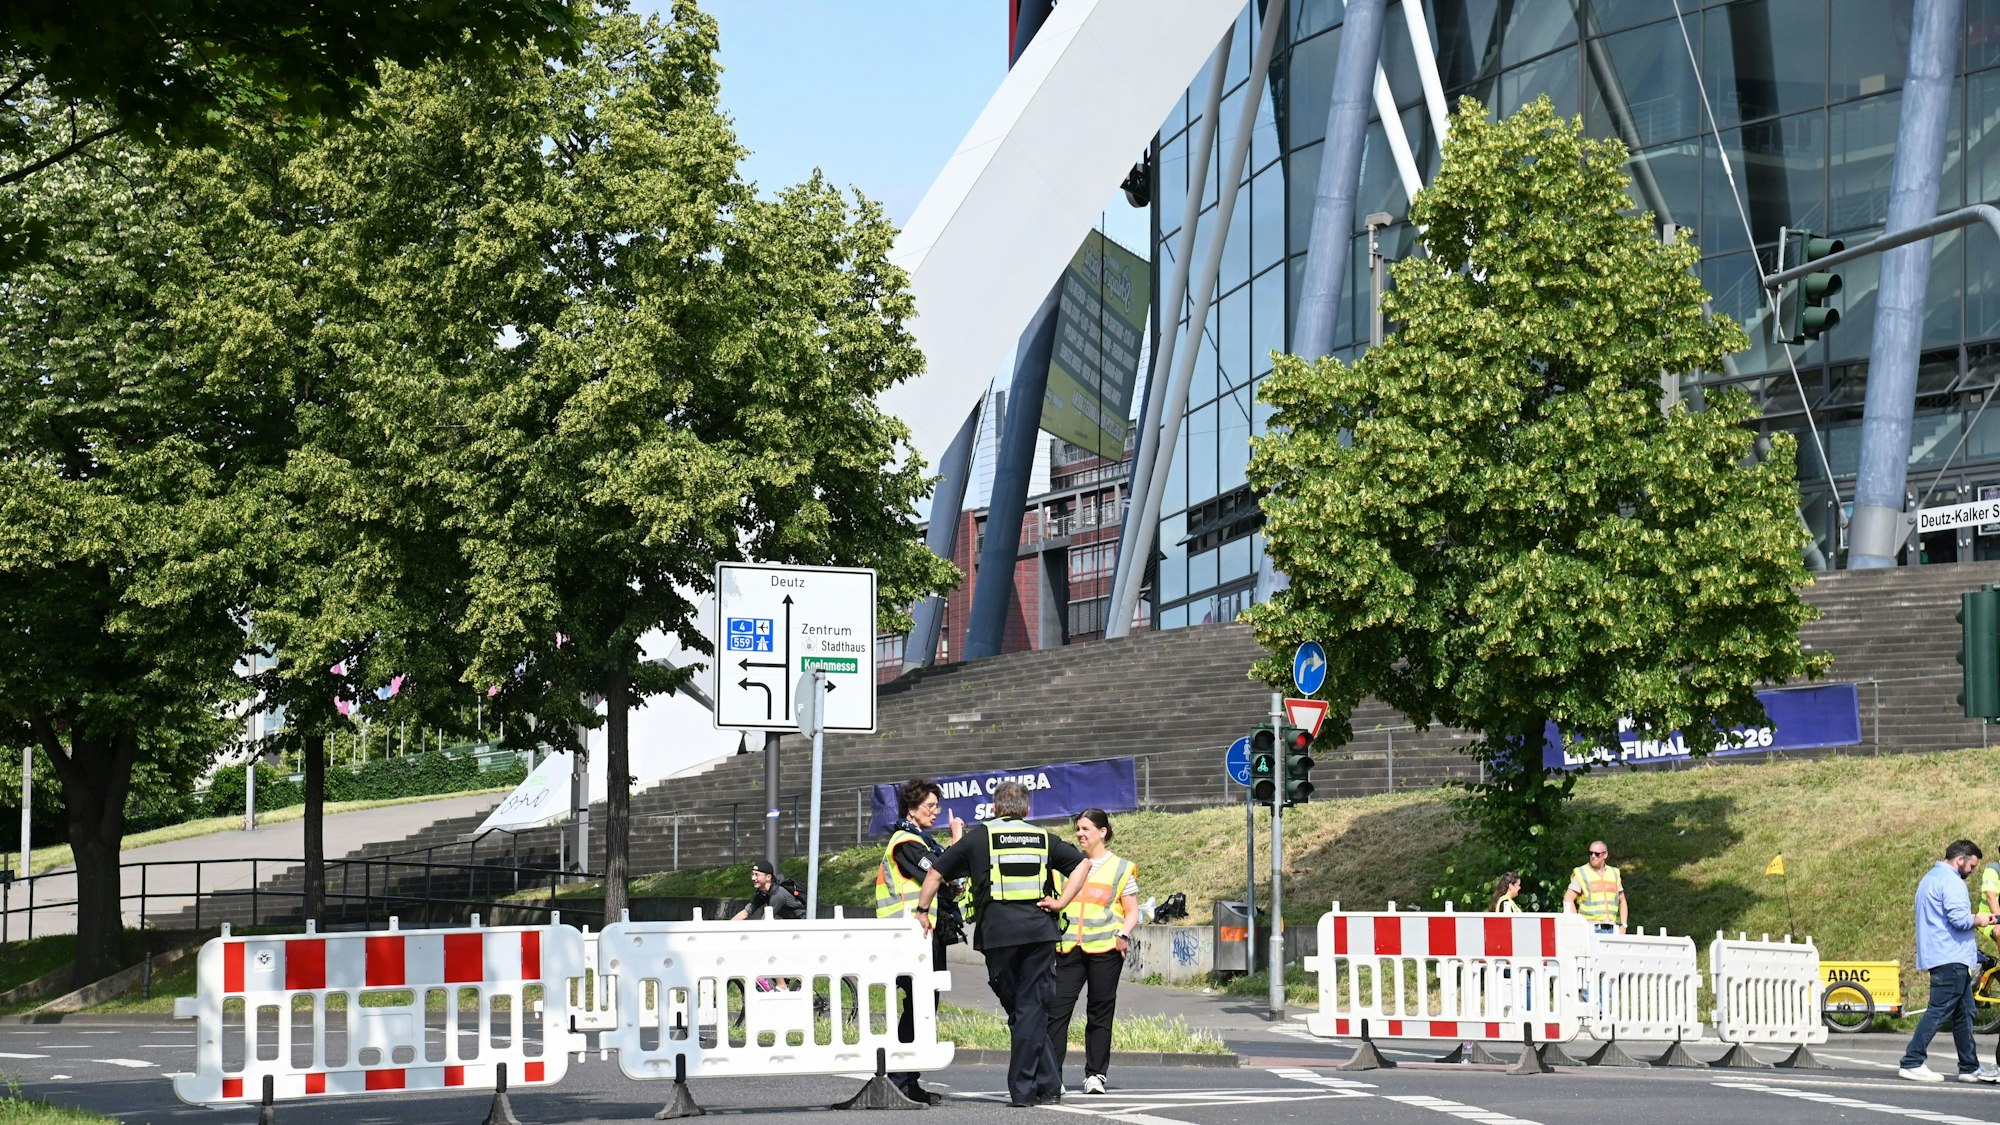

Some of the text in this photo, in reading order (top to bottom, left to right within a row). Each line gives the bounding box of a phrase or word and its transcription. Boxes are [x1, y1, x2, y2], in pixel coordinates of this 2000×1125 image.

[1921, 507, 1989, 528] Deutz-Kalker
[771, 575, 806, 588] Deutz
[739, 622, 746, 631] 4
[801, 623, 852, 636] Zentrum
[733, 637, 751, 648] 559
[821, 640, 866, 653] Stadthaus
[804, 658, 856, 672] Koelnmesse
[1715, 727, 1773, 751] 2026
[937, 779, 982, 799] NINA
[1000, 835, 1040, 845] Ordnungsamt
[1828, 969, 1870, 982] ADAC
